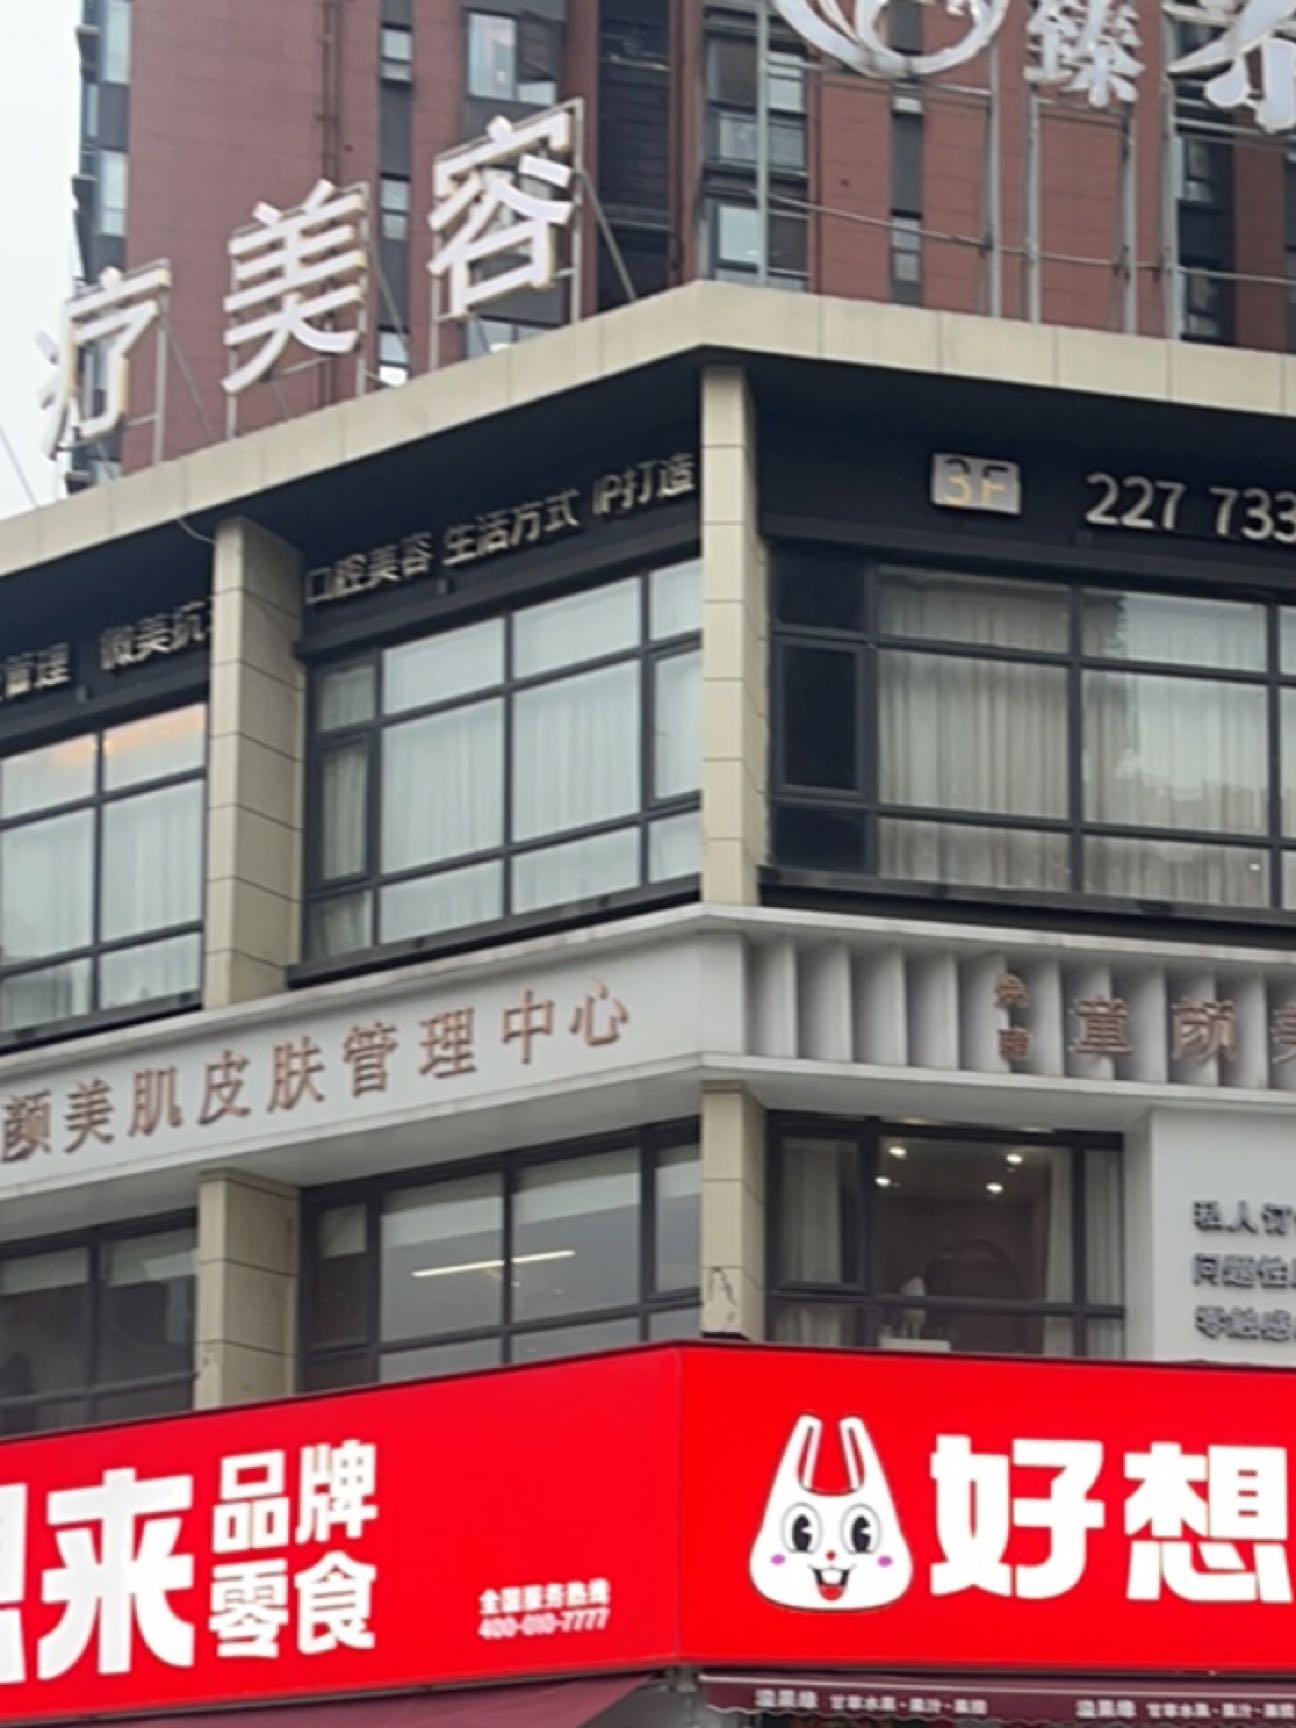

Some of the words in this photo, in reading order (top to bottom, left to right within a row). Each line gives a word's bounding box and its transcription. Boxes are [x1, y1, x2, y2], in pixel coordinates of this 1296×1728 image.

[442, 488, 580, 567] 生活方式
[1087, 474, 1186, 530] 227
[0, 982, 629, 1164] 颜美肌皮肤管理中心
[213, 1440, 378, 1554] 品牌
[0, 1469, 195, 1684] 来
[209, 1551, 376, 1659] 零食
